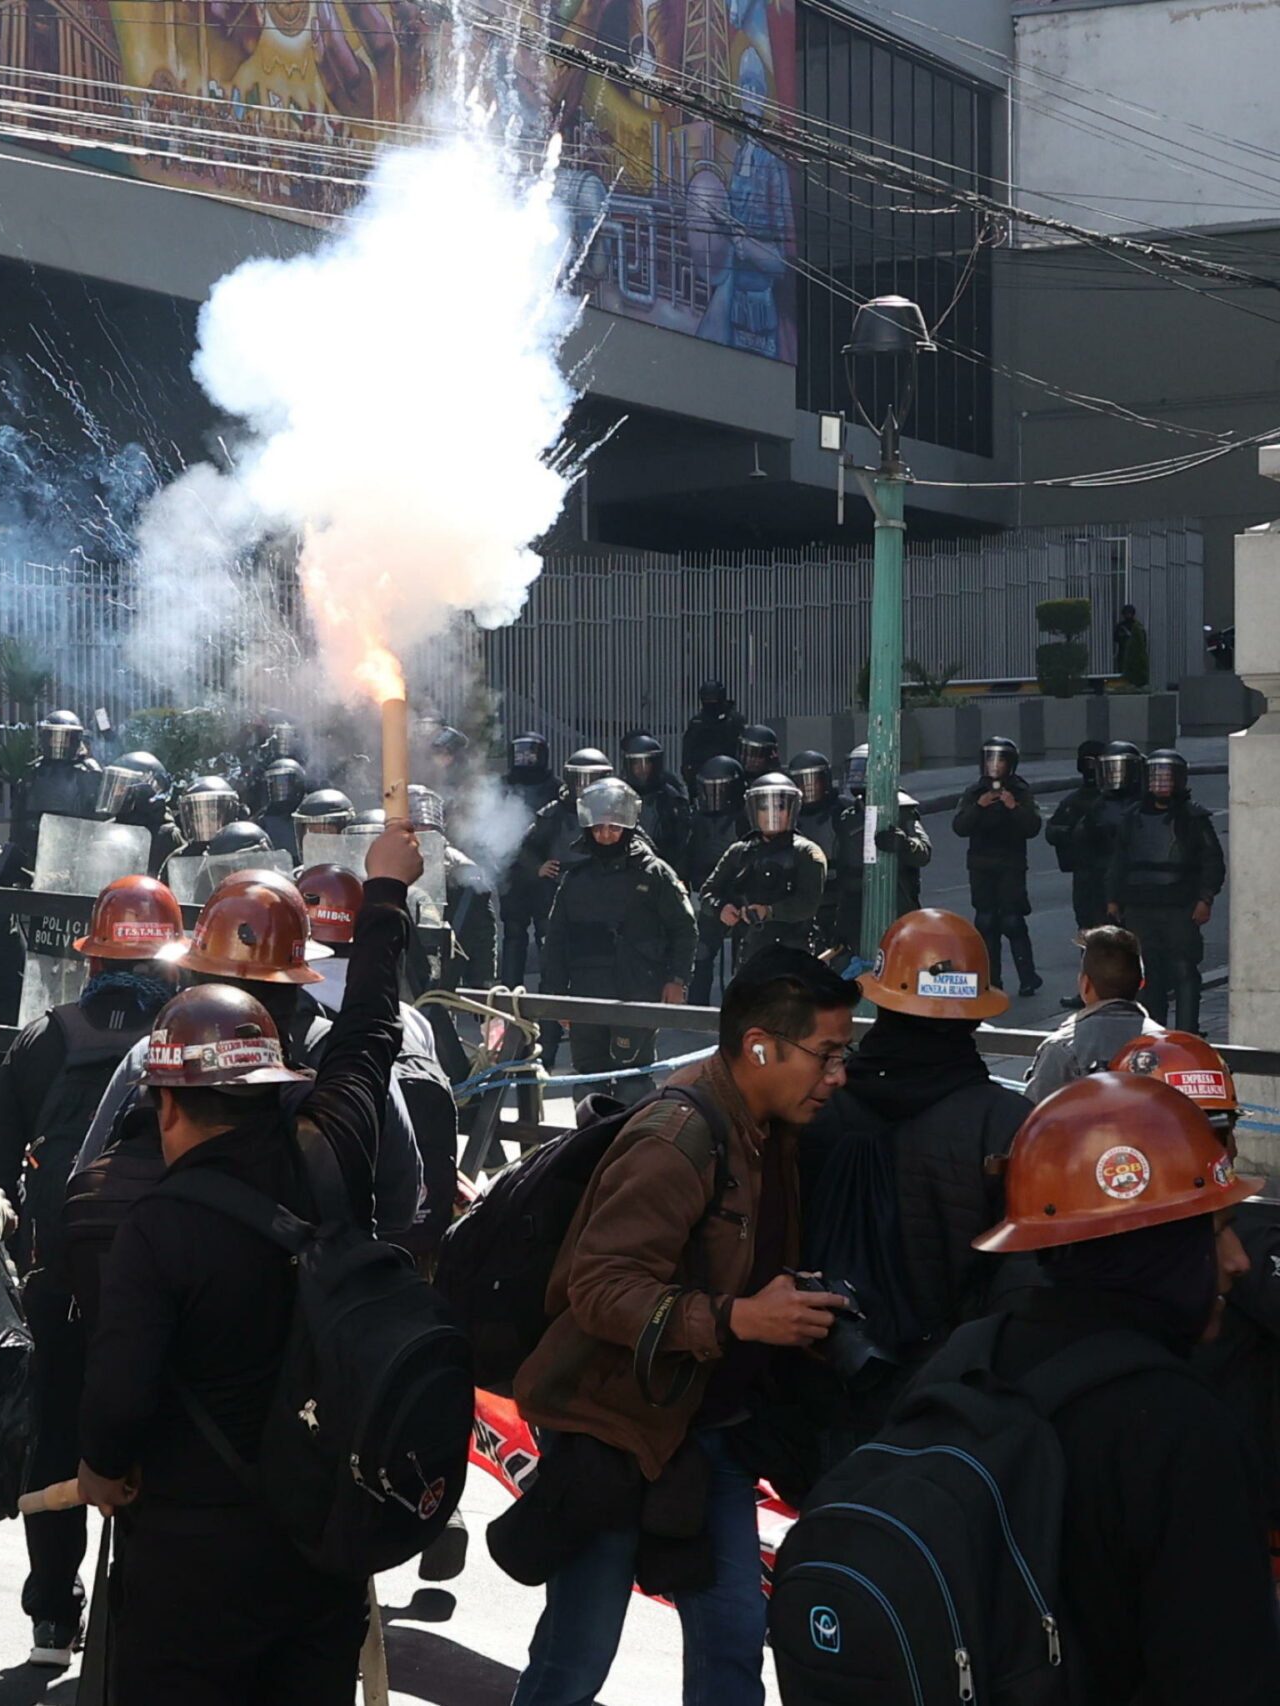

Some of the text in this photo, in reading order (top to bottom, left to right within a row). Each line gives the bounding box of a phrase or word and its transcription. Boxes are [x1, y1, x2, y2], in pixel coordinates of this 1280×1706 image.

[35, 929, 77, 948] BOLIV
[933, 974, 968, 985] EMPRESA
[1181, 1073, 1216, 1084] EMPRESA
[1103, 1162, 1142, 1177] COB
[652, 1295, 674, 1325] Nikon
